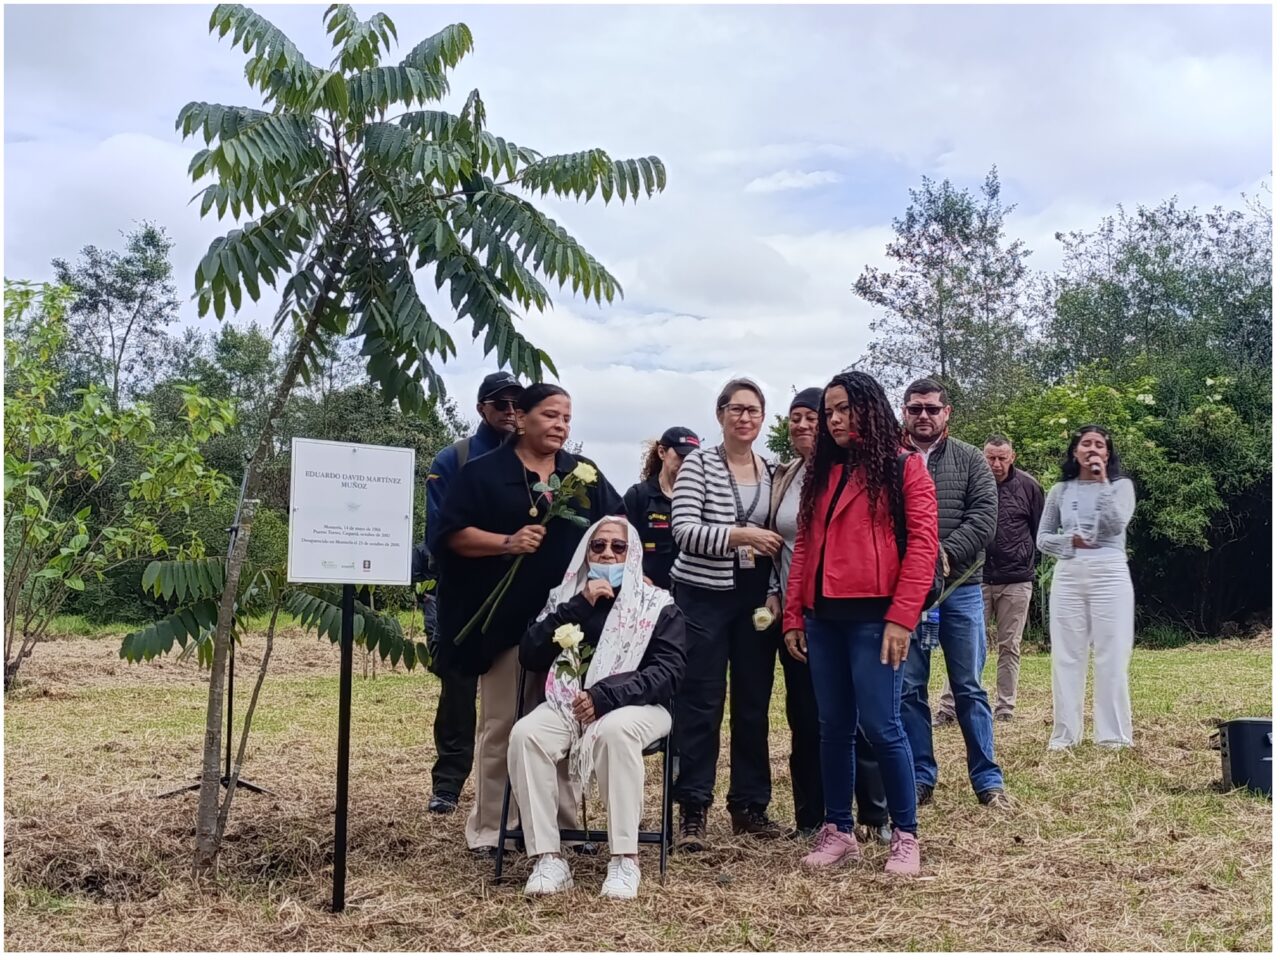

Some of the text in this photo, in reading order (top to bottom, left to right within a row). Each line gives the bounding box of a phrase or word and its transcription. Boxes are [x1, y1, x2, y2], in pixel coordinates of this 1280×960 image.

[305, 471, 340, 479] EDUARDO
[366, 475, 402, 484] MARTÍNEZ
[340, 481, 367, 489] MUÑOZ
